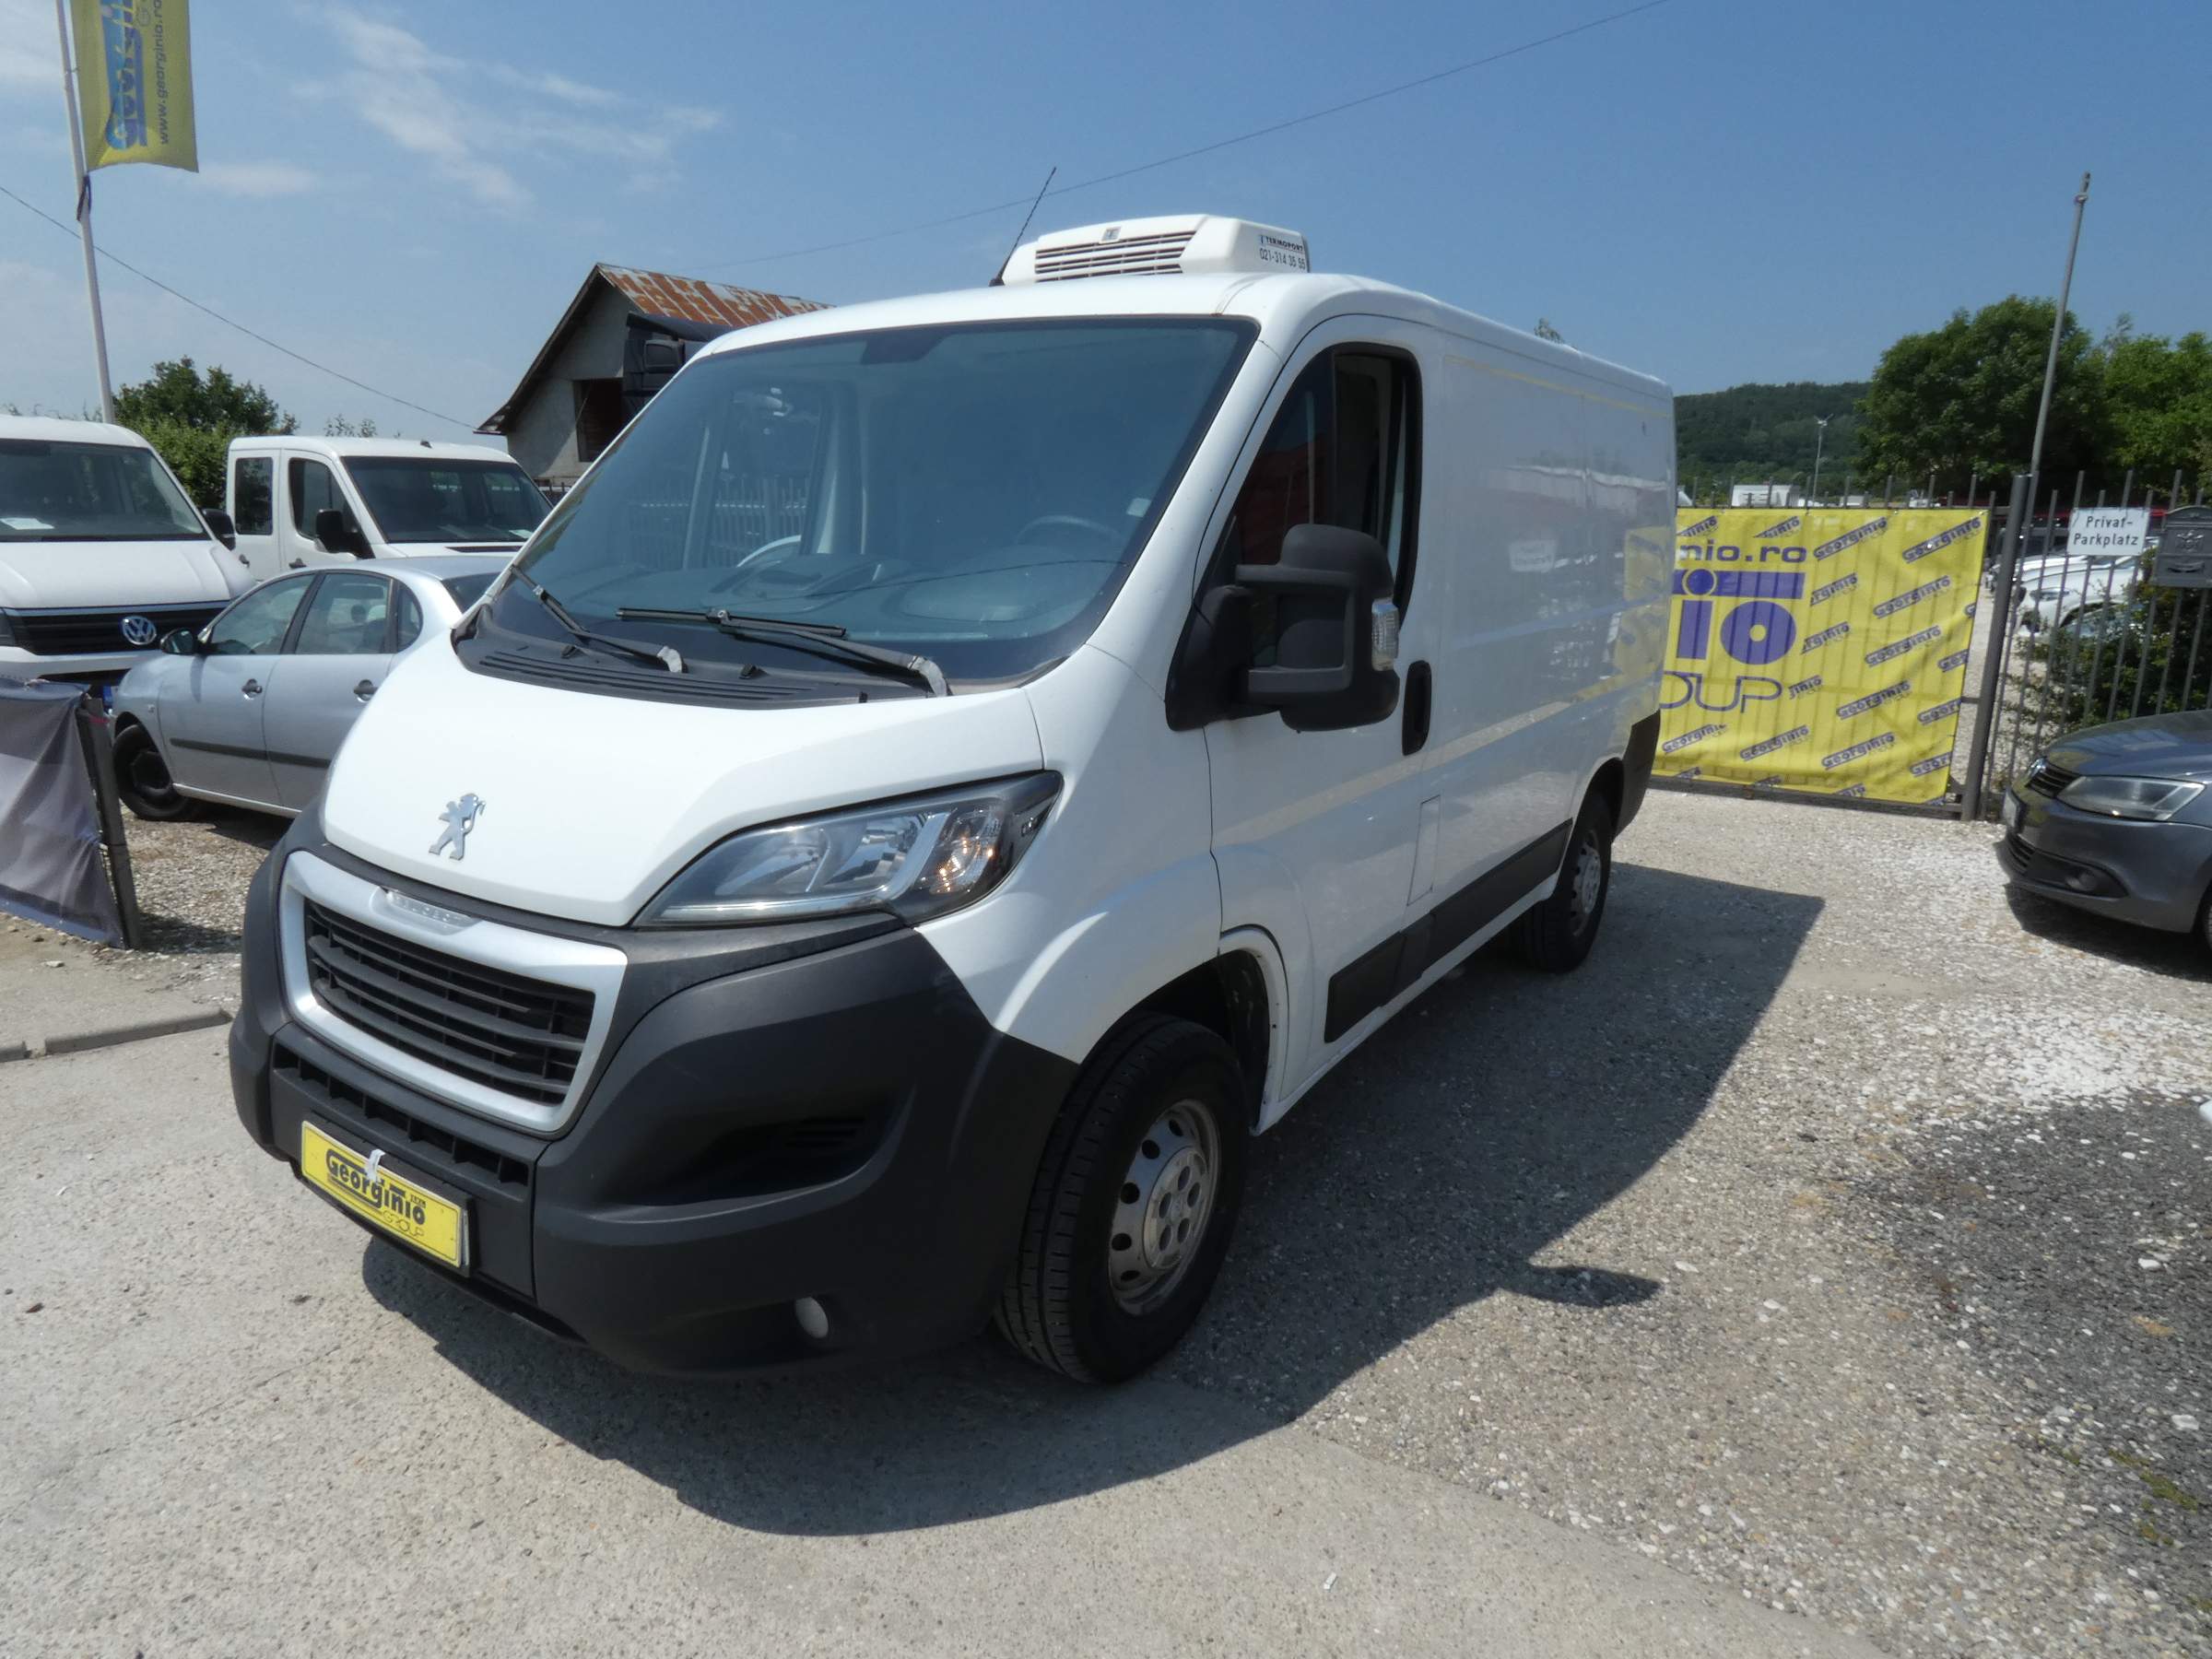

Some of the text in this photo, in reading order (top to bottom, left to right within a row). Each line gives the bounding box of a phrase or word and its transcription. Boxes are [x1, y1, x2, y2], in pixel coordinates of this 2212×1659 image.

[2086, 515, 2134, 528] Privat-
[1679, 538, 1807, 562] nio.ro
[2073, 532, 2139, 548] Parkplatz
[325, 1148, 427, 1226] Georginio
